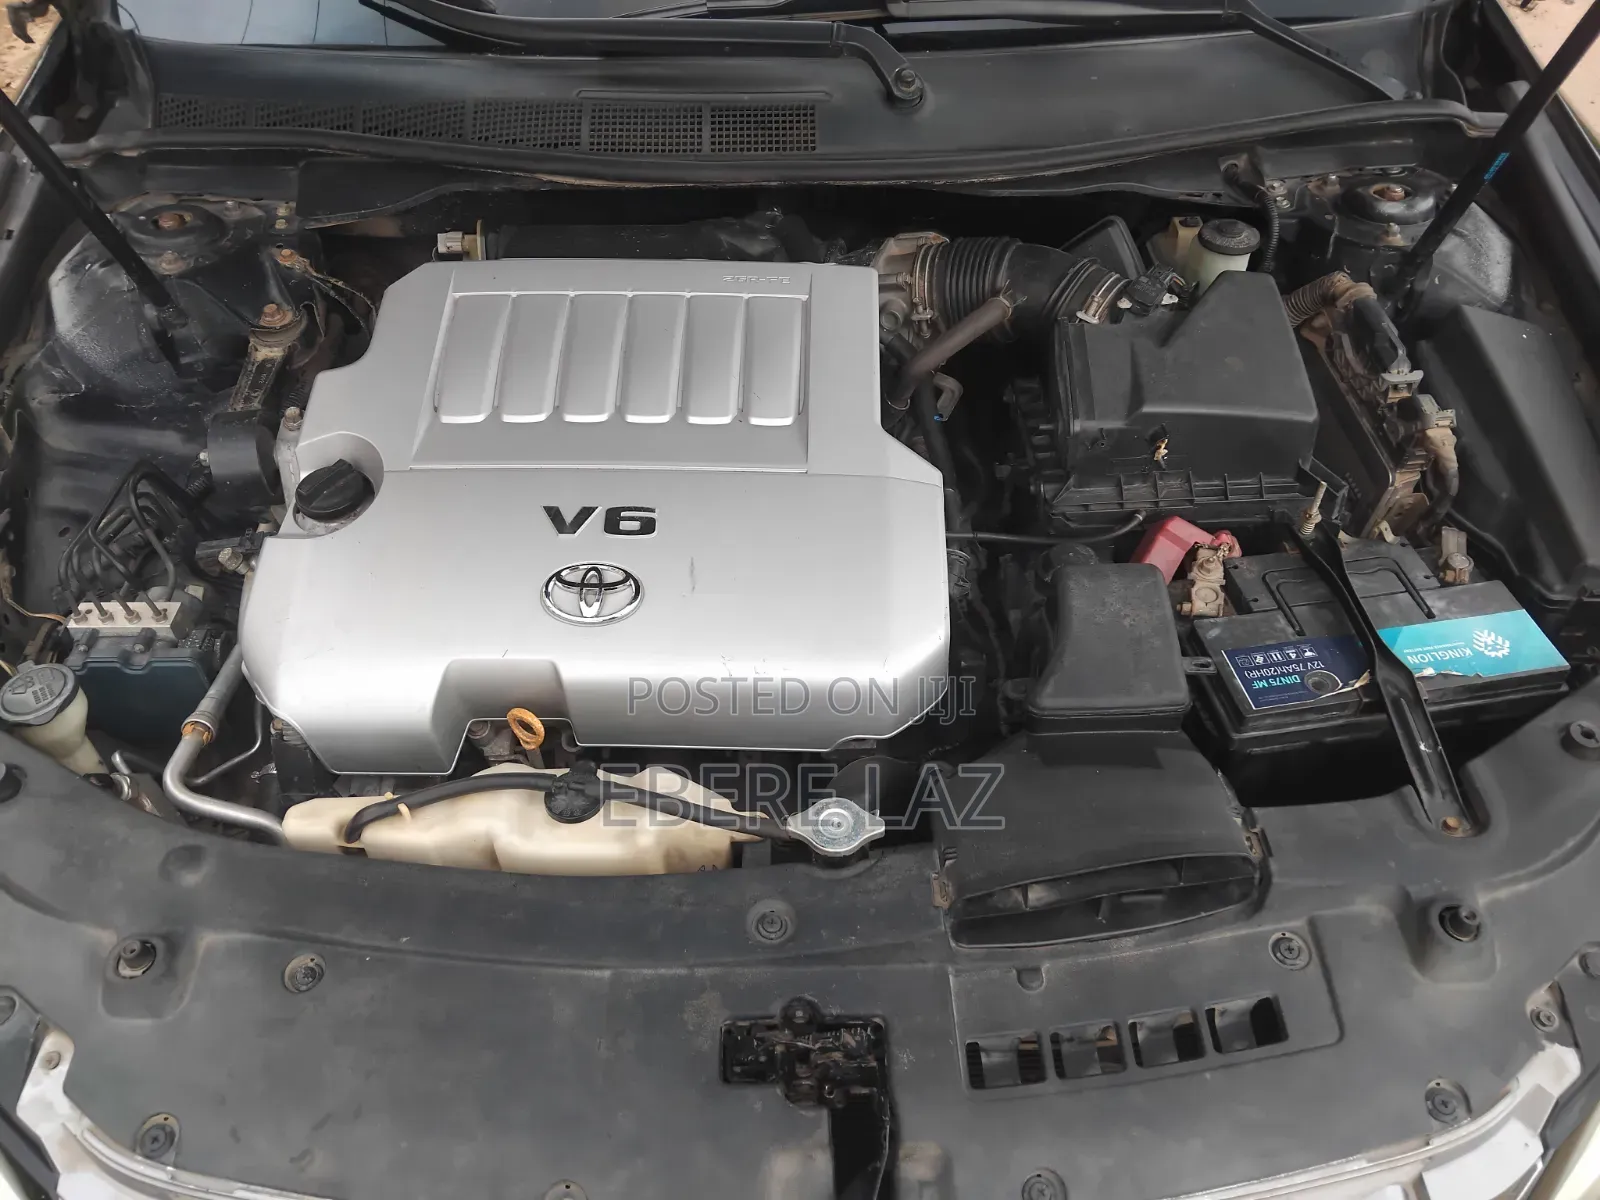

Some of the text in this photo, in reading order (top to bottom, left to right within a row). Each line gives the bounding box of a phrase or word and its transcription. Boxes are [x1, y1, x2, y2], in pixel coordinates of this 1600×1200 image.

[541, 505, 658, 539] V6
[1406, 646, 1474, 664] KINGLION
[1244, 660, 1325, 680] 12V 75Ah(20HR)
[1252, 674, 1301, 689] DIN75 MF
